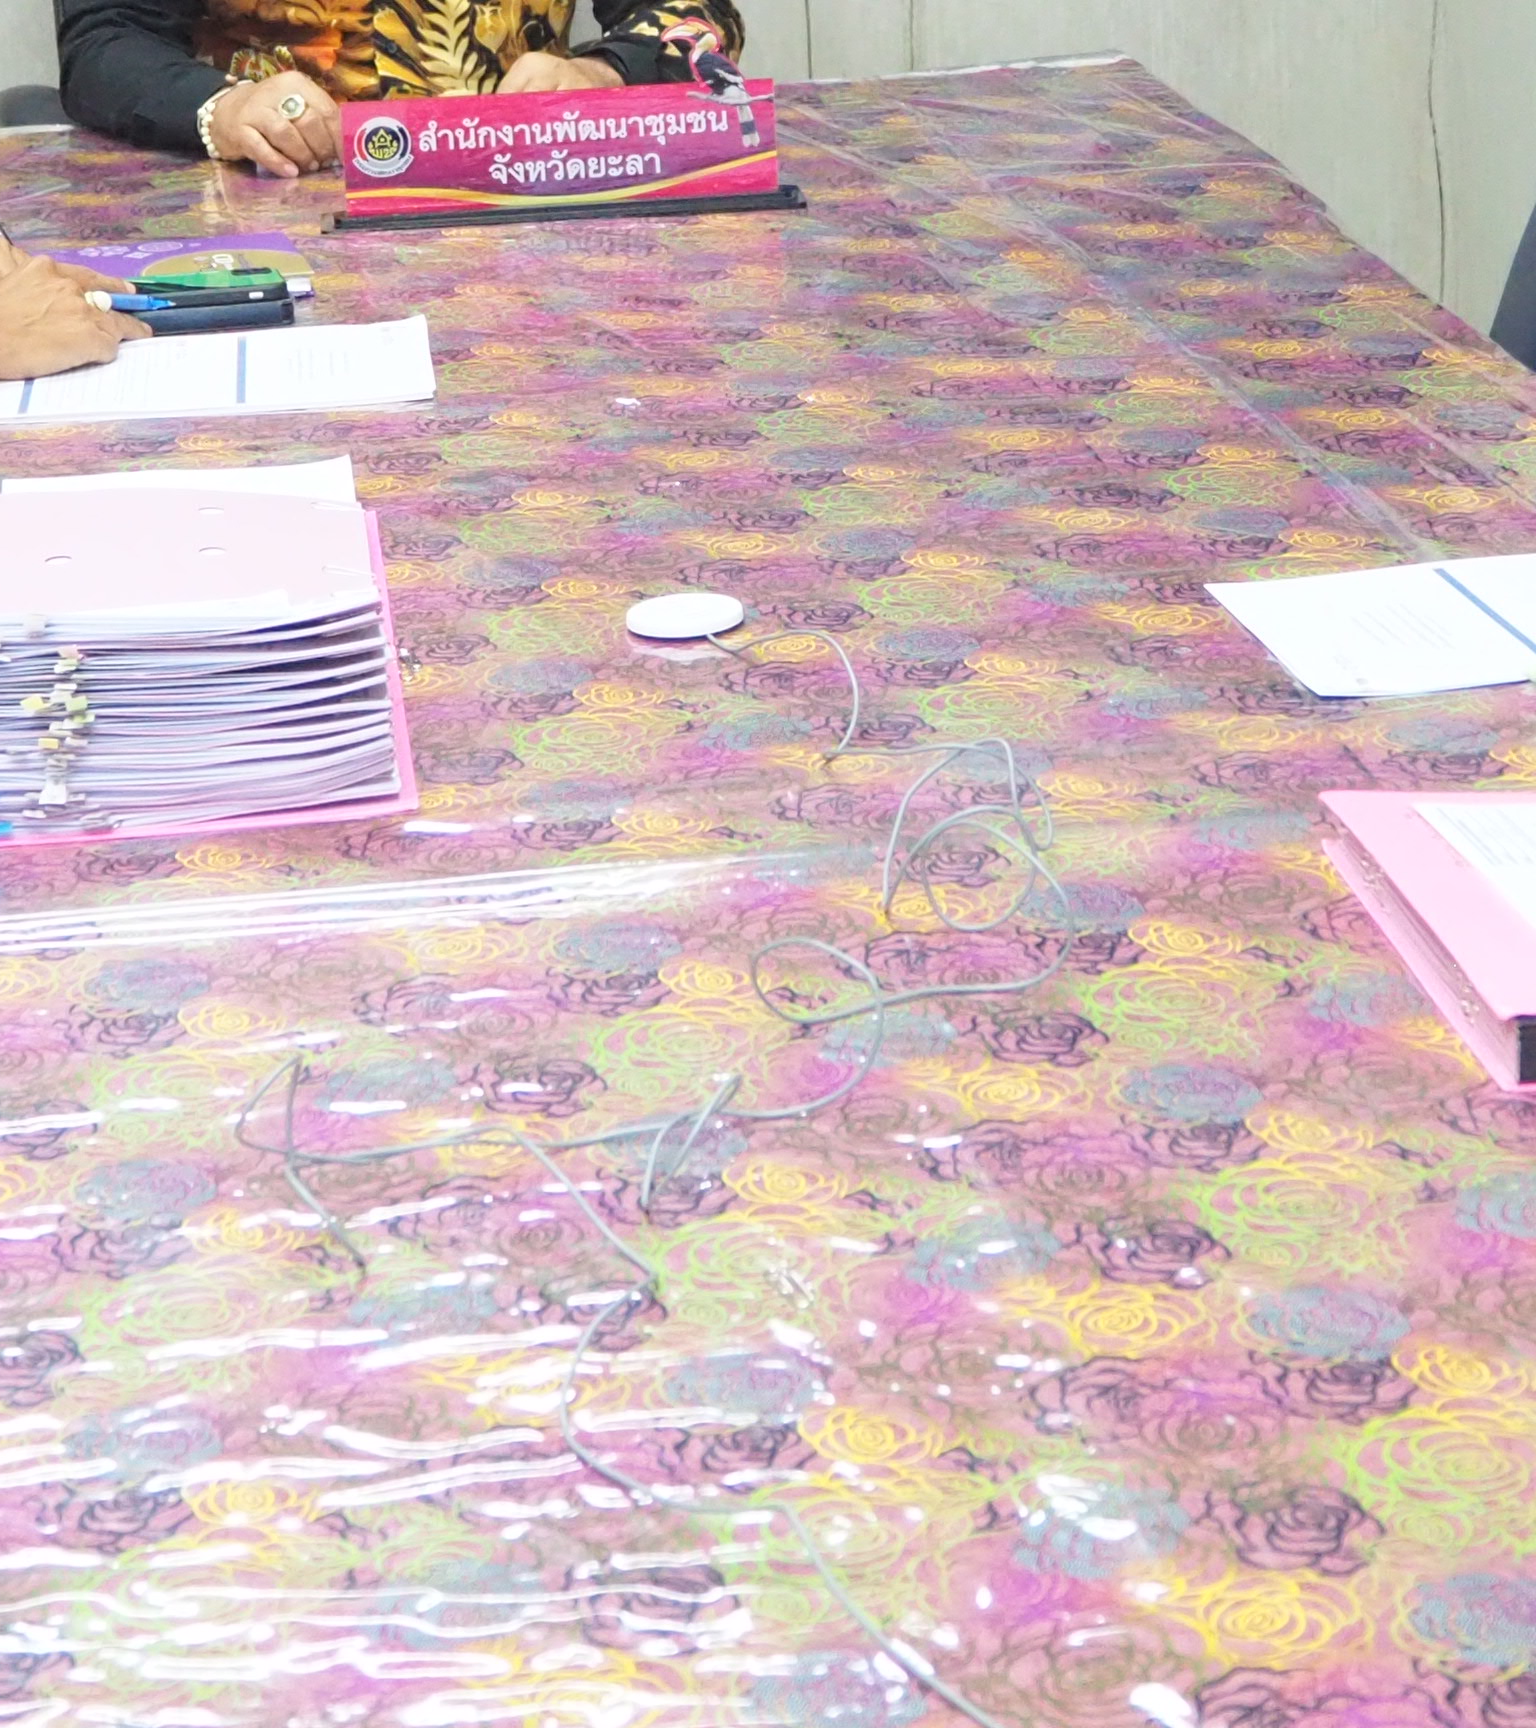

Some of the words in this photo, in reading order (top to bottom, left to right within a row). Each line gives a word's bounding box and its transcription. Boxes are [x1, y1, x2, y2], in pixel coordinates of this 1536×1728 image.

[417, 108, 730, 153] สำนักงานพัฒนาชุมชน
[488, 149, 663, 186] จังหวัดยะลา
